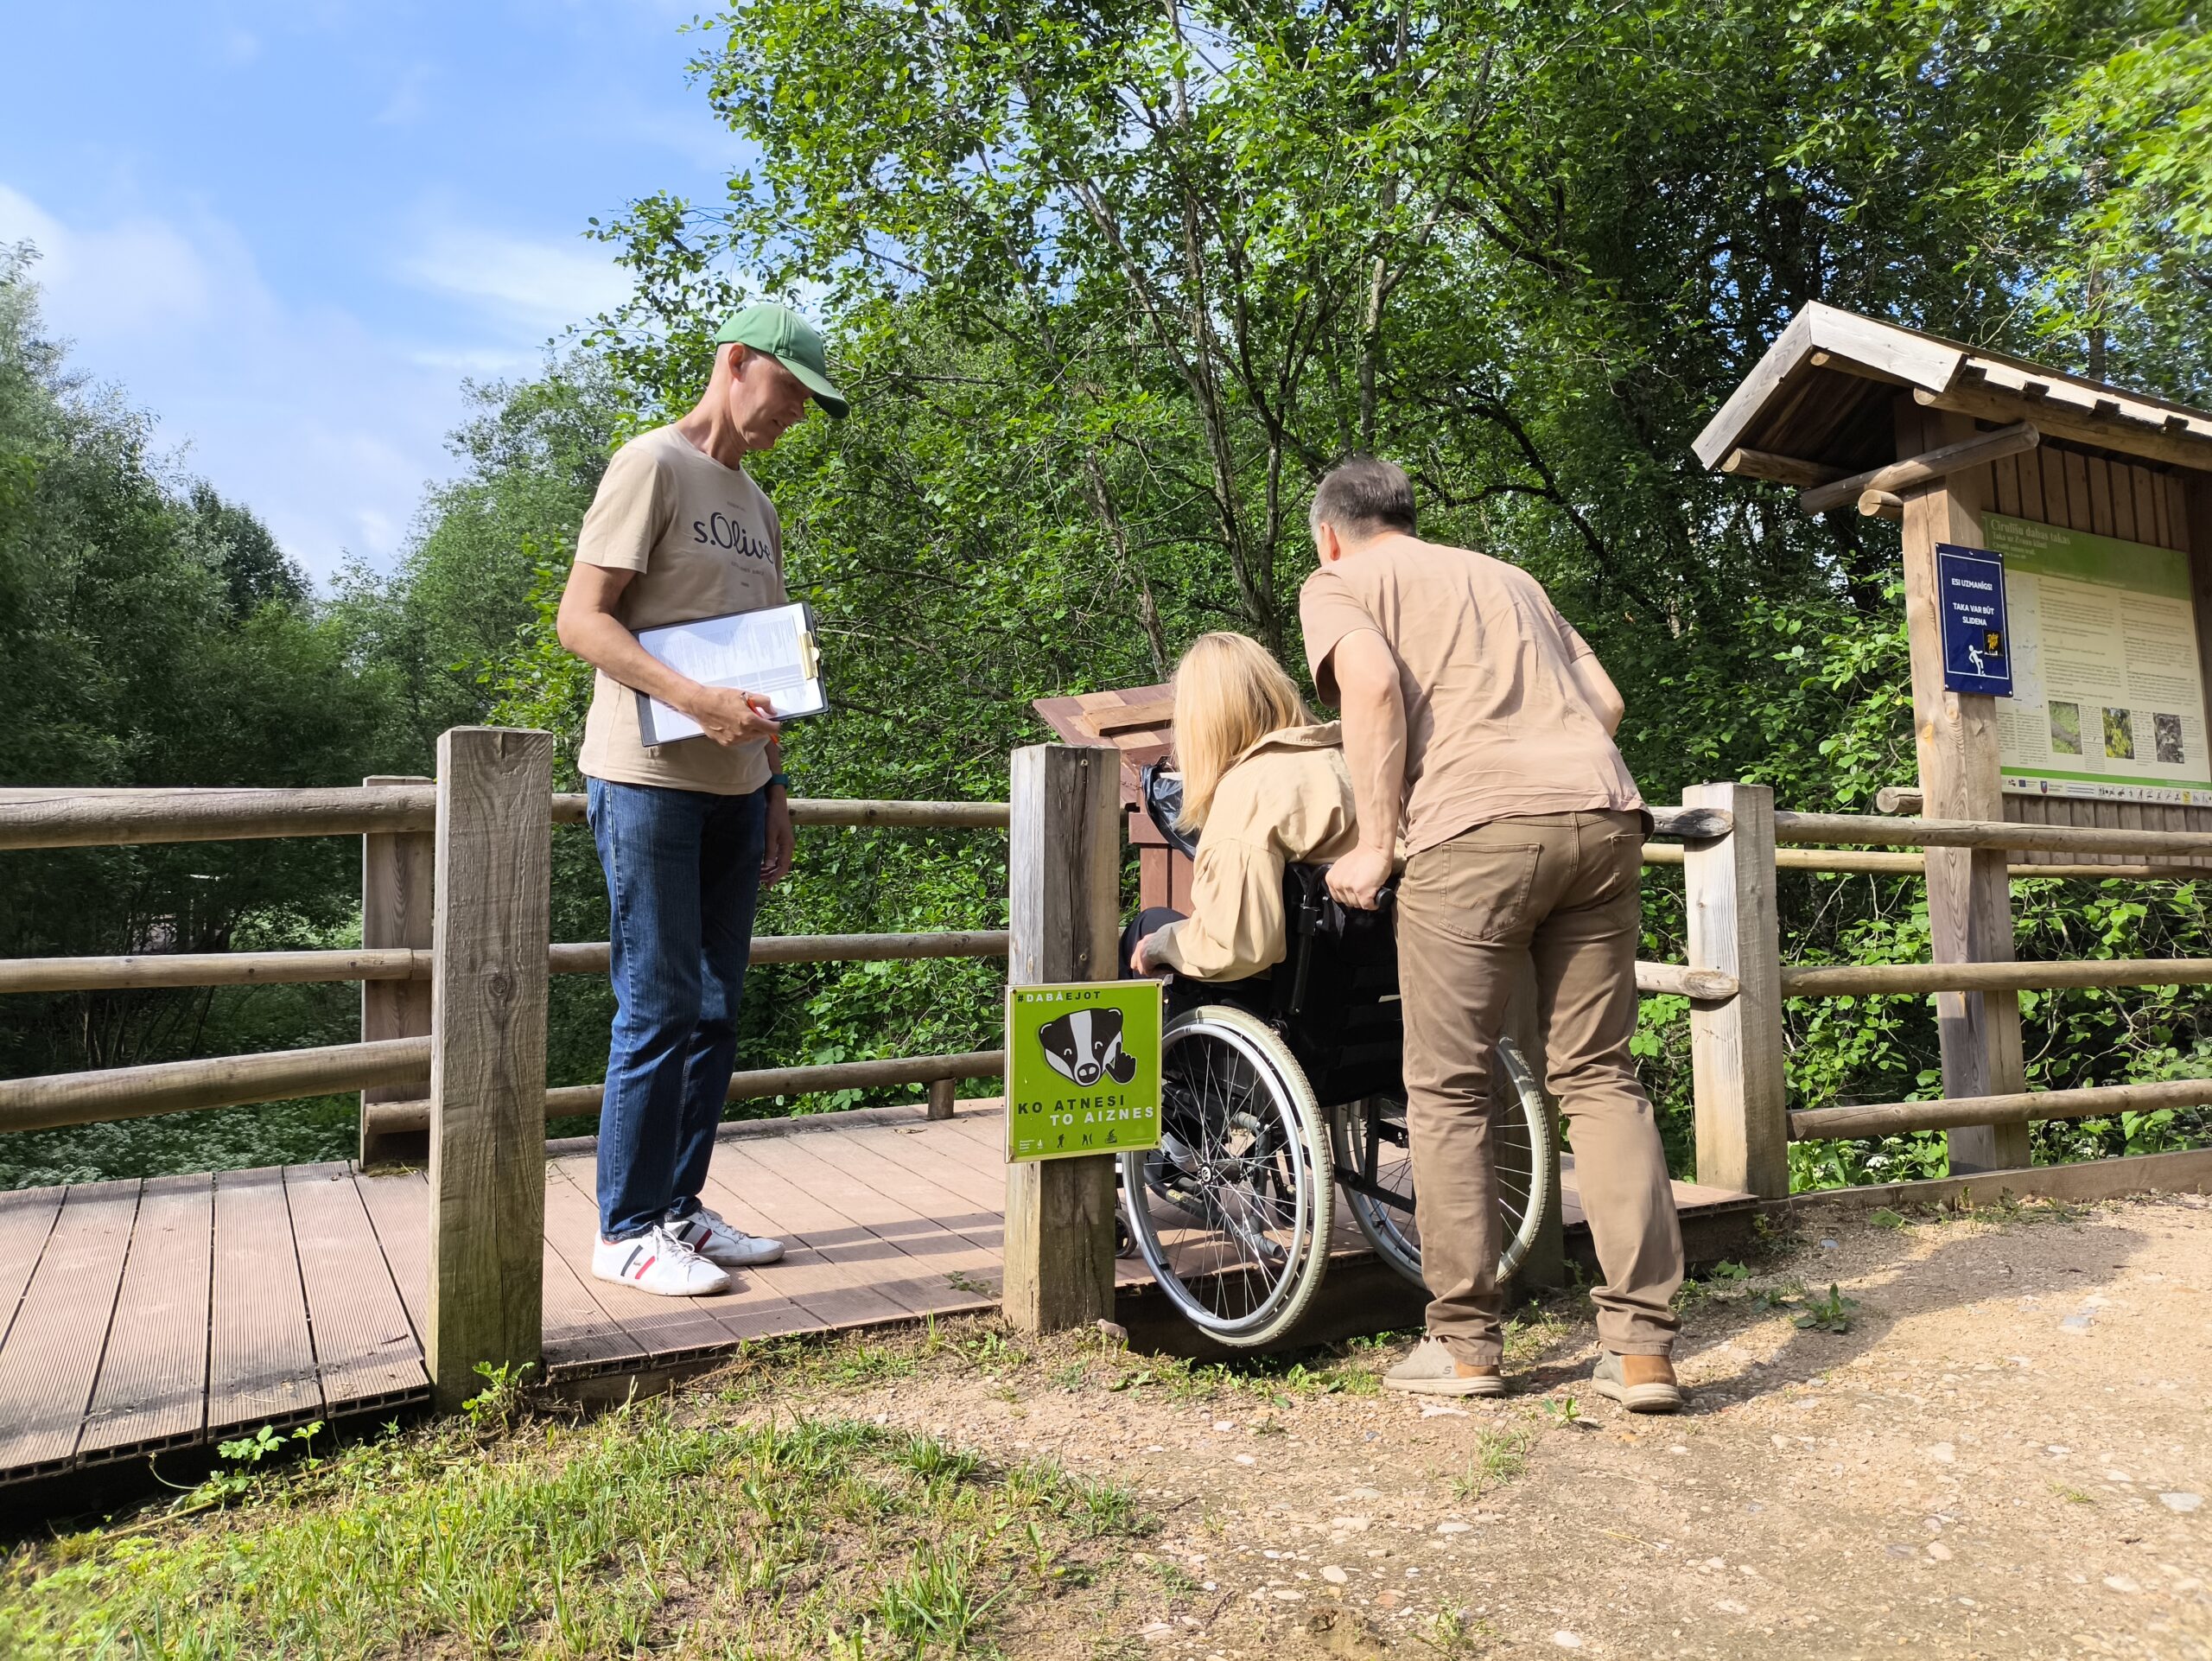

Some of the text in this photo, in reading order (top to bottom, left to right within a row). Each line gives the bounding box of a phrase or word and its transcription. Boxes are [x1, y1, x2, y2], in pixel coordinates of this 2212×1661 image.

[2025, 526, 2049, 540] dabas
[2050, 532, 2071, 544] takas
[1953, 602, 1994, 614] TAKA VAR BŪT
[1962, 616, 1987, 627] SLIDENA
[1017, 990, 1101, 1003] #DABĀEJOT
[1018, 1095, 1124, 1115] KO ATNESI
[1050, 1106, 1154, 1127] TO AIZNES
